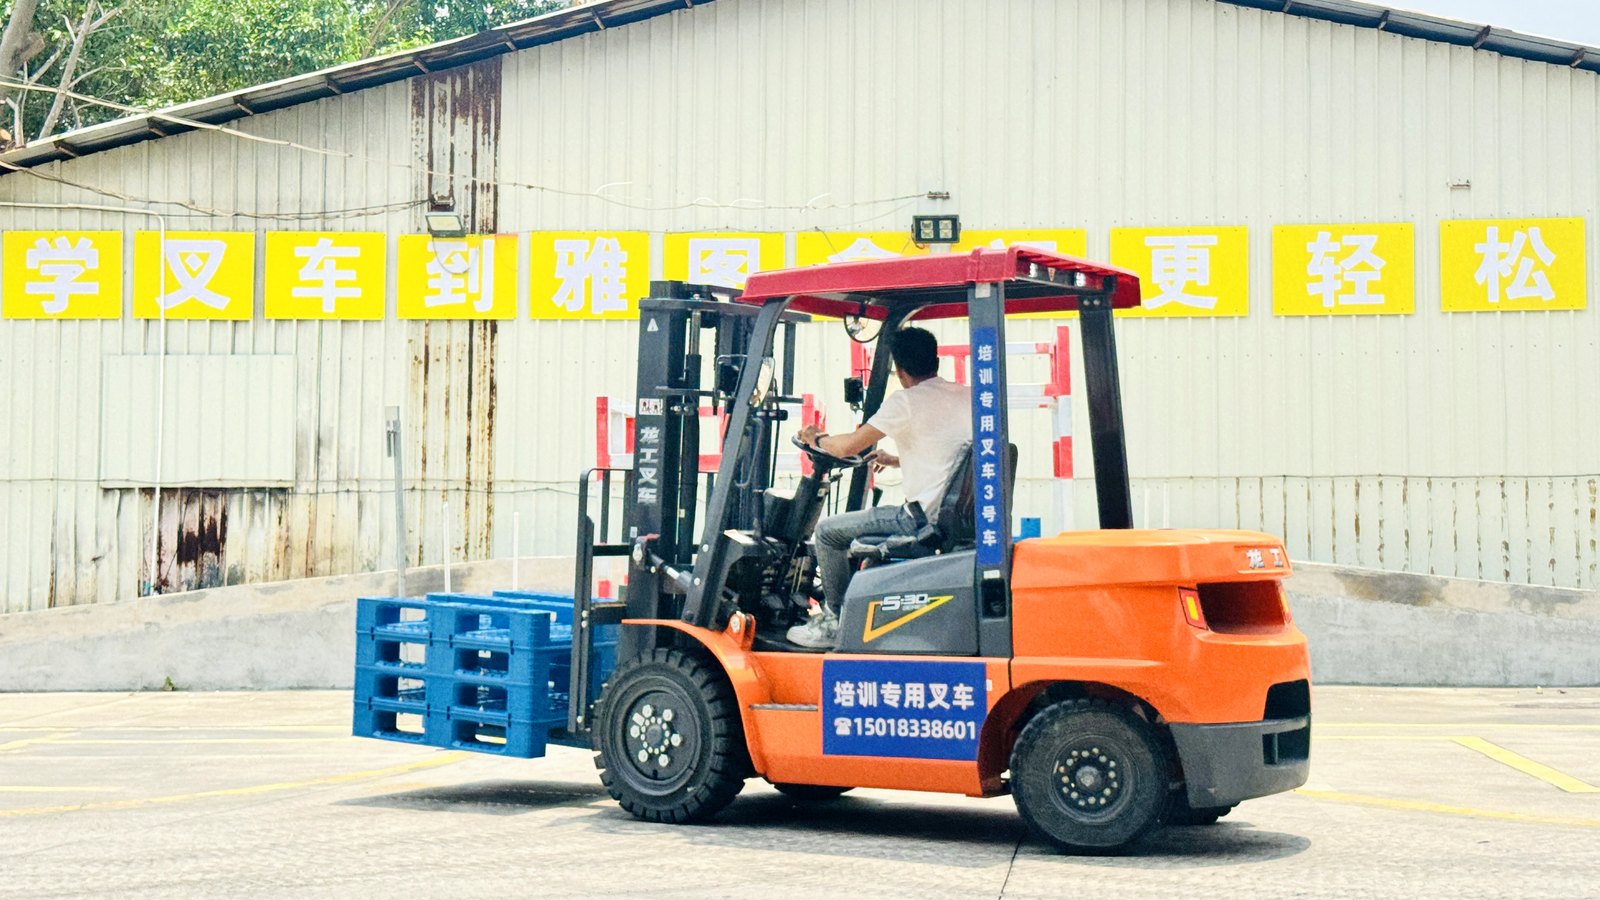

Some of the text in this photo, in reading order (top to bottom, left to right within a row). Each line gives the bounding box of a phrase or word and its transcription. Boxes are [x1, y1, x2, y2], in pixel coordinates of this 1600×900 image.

[25, 226, 1556, 314] 学叉车到雅图更轻松
[978, 344, 997, 547] 培训专用叉车3号车
[833, 680, 975, 711] 培训专用叉车
[854, 717, 976, 740] 15018338601
